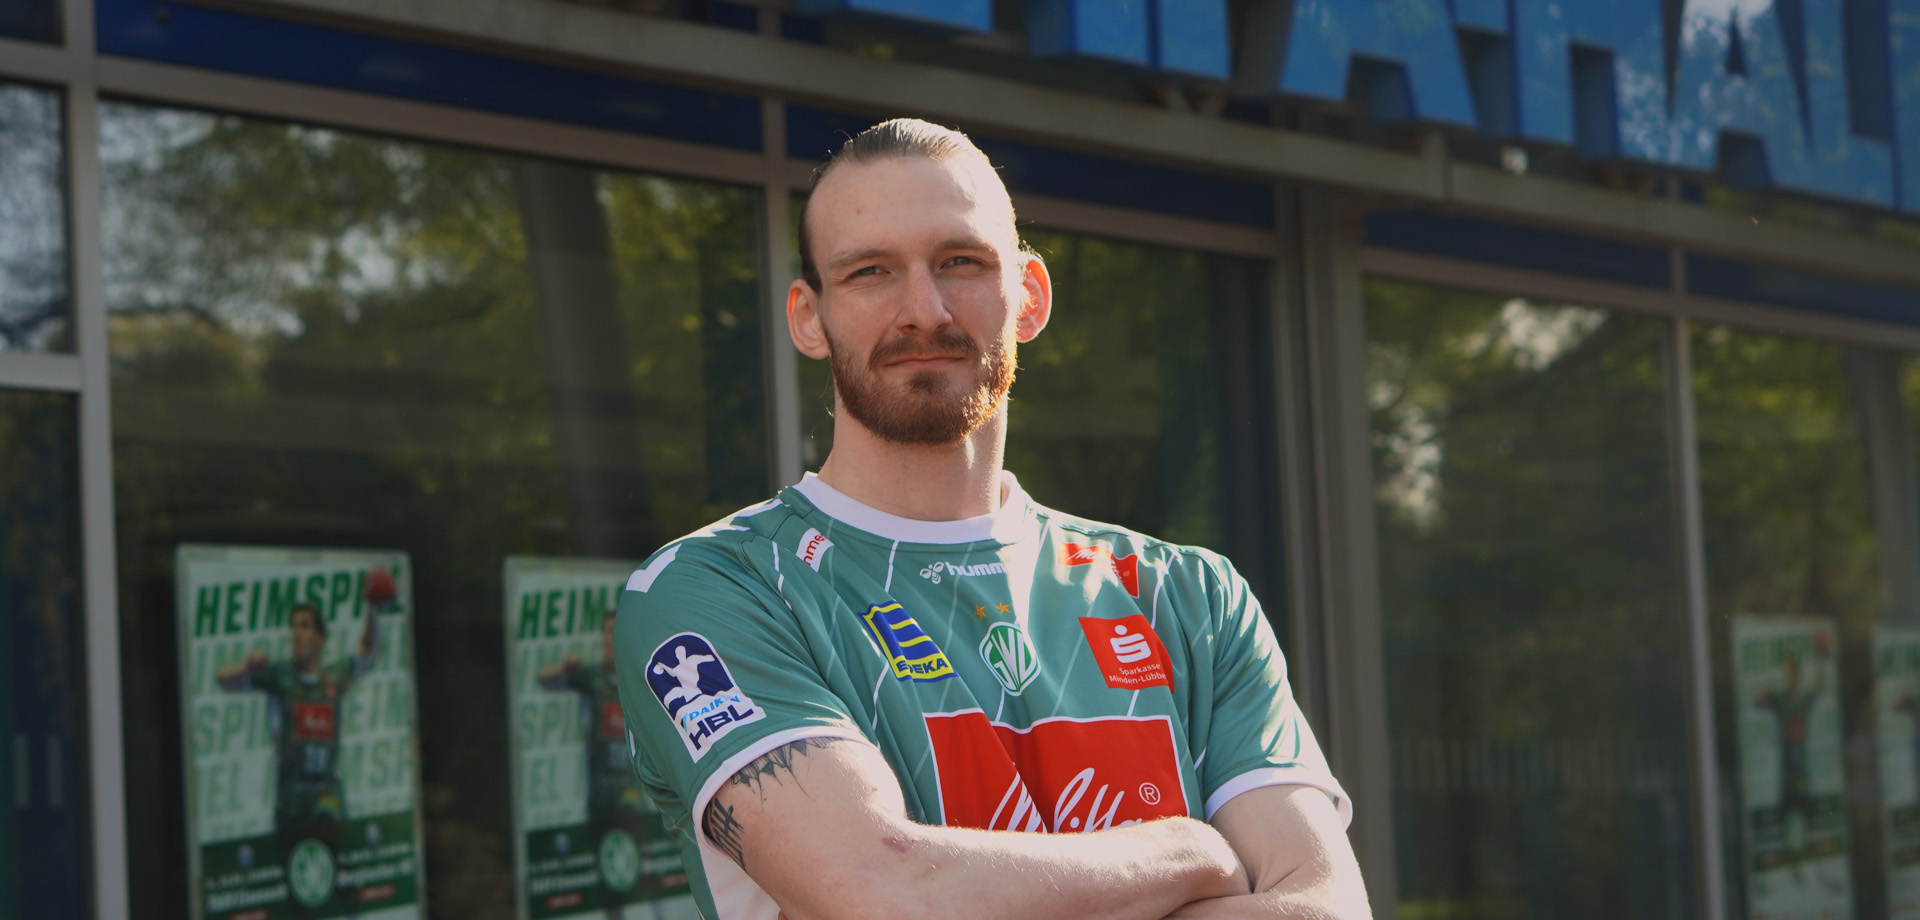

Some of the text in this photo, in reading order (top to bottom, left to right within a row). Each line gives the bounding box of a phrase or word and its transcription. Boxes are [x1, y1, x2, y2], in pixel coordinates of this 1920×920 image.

[945, 561, 1008, 577] humm
[194, 564, 404, 638] HEIMSPI
[517, 586, 624, 640] HEIM
[1109, 672, 1167, 684] Minden-Lübbe
[1119, 663, 1161, 676] Sparkasse
[688, 695, 741, 721] DAIKN
[689, 704, 755, 751] HBL
